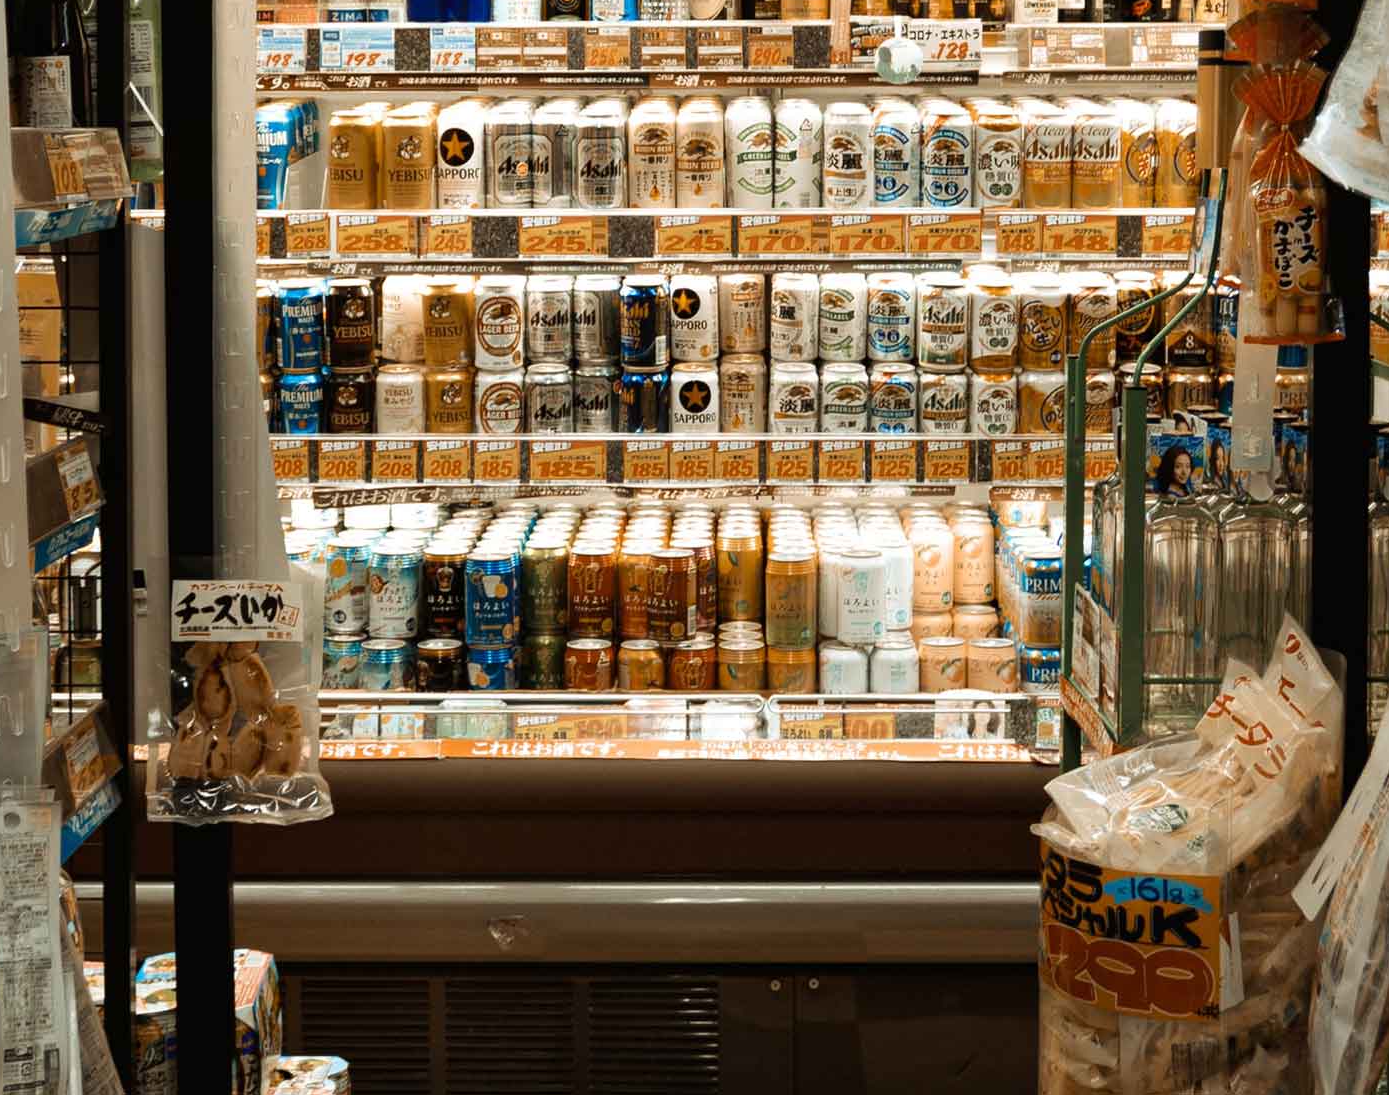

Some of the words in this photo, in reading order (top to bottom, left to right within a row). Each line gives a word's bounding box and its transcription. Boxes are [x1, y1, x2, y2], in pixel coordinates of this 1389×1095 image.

[909, 29, 981, 42] コロナ・エキストラ
[1294, 206, 1320, 264] チーズ
[1023, 578, 1062, 594] PRIM
[174, 592, 285, 625] チーズいか
